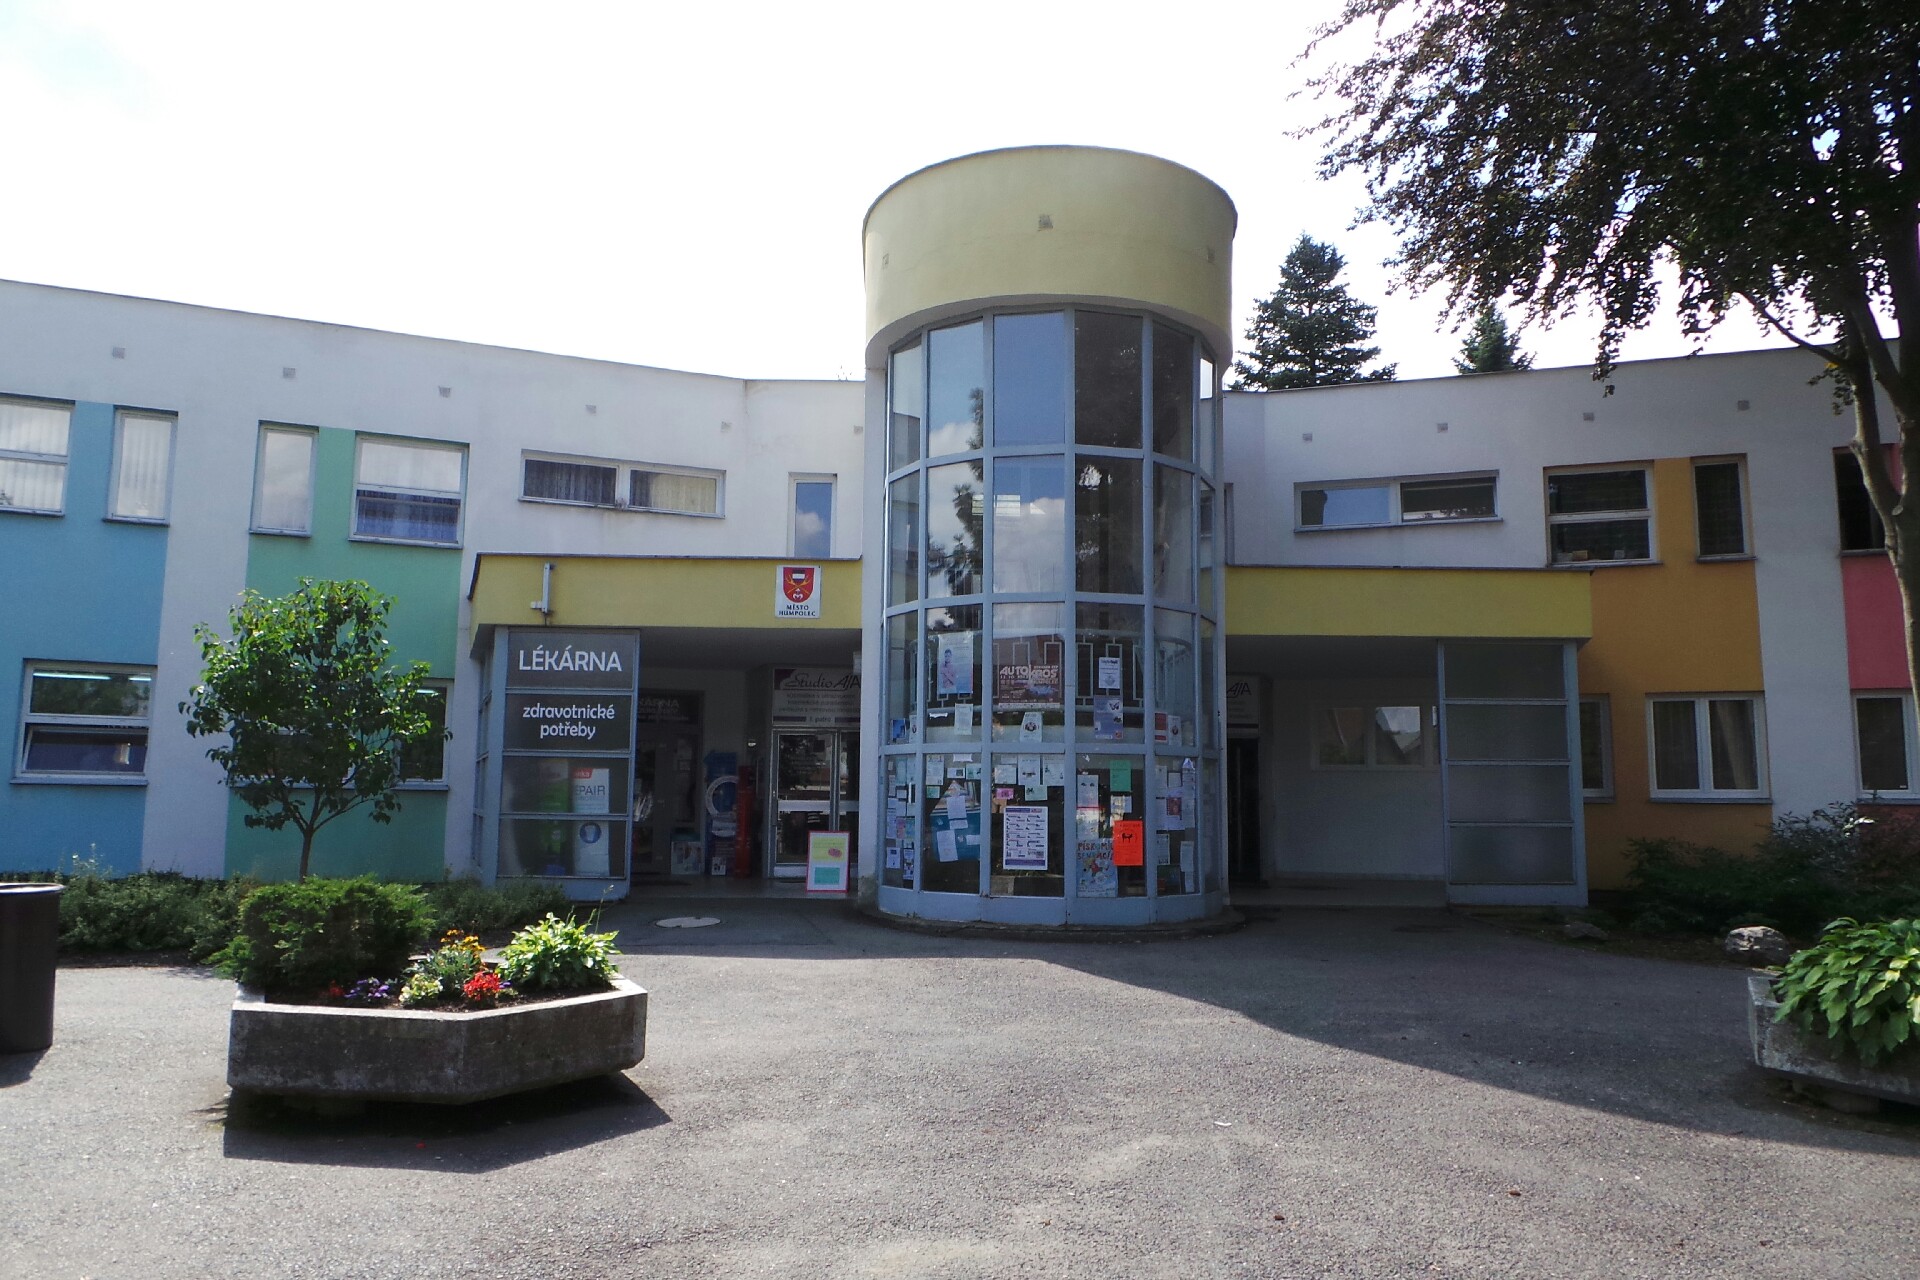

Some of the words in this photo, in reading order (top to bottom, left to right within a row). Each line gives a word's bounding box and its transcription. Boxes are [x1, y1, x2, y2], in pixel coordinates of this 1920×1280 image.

[786, 603, 809, 611] MĚSTO
[519, 644, 623, 672] LÉKÁRNA
[785, 672, 833, 688] Studio
[522, 702, 616, 720] zdravotnické
[540, 721, 596, 740] potřeby
